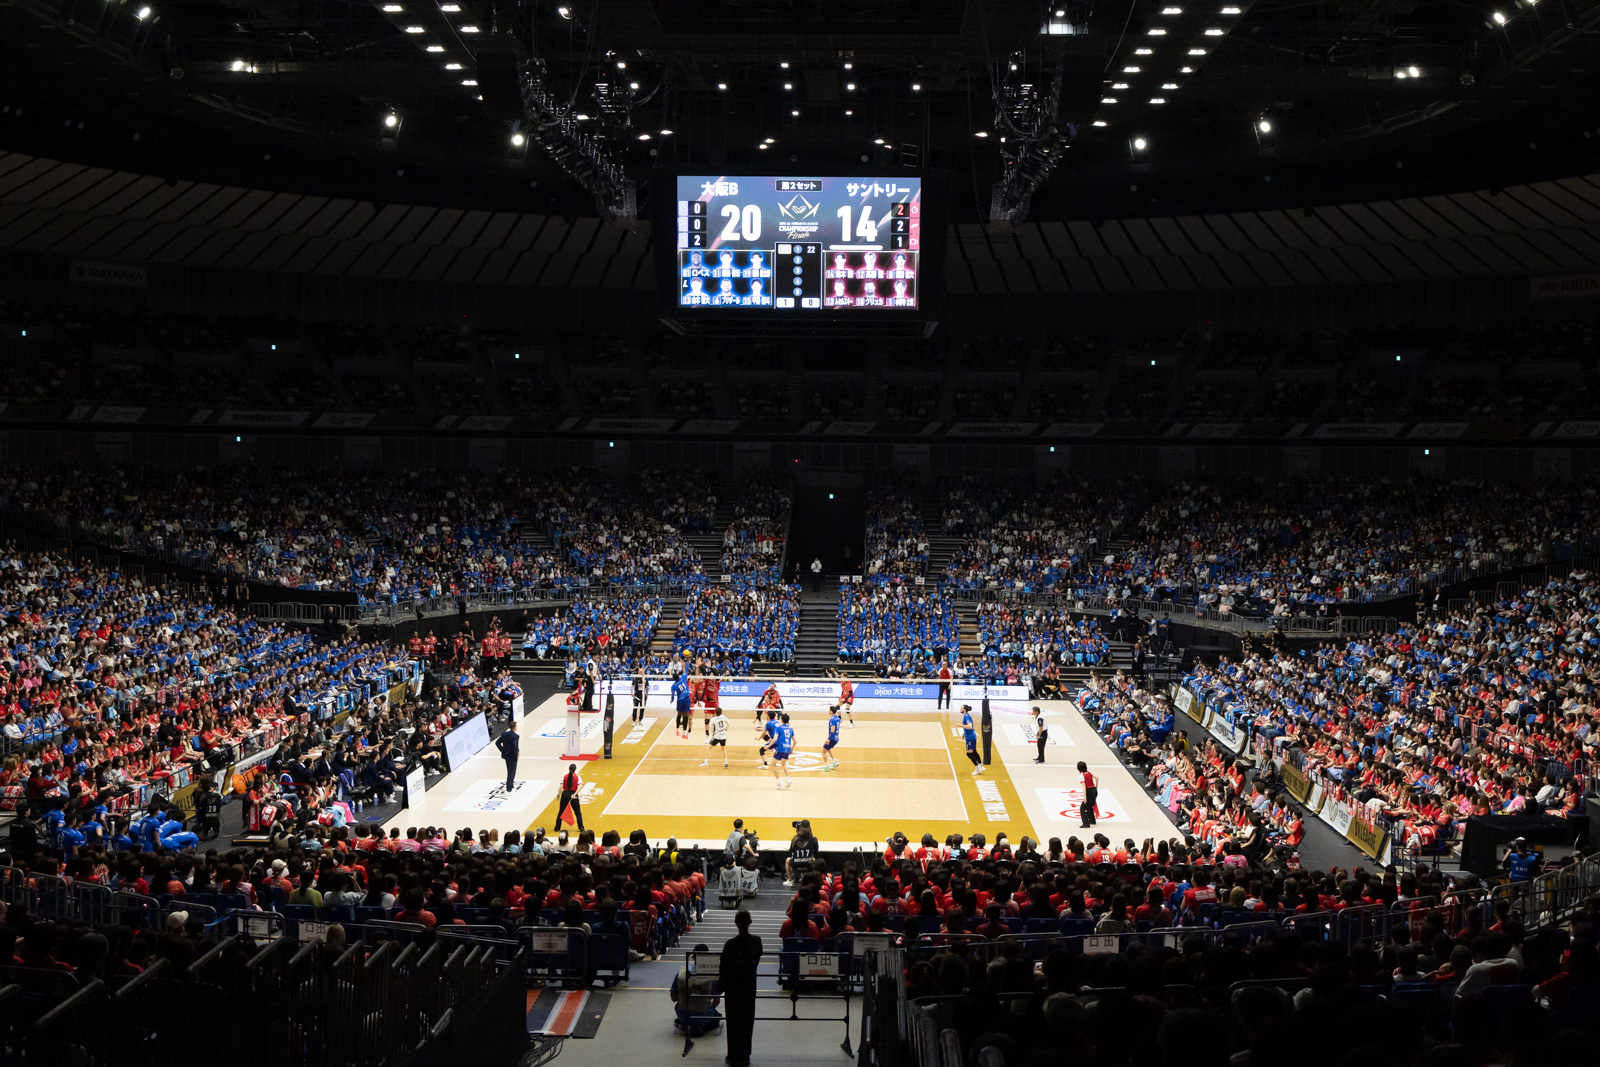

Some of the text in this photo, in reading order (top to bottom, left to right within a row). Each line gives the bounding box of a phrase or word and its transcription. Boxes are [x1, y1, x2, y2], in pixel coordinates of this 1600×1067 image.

[701, 182, 739, 196] 大阪B
[781, 181, 816, 190] 第2セット
[846, 183, 910, 197] サントリー
[694, 203, 701, 214] 0
[897, 205, 904, 216] 2
[694, 219, 701, 230] 0
[721, 204, 762, 241] 20
[837, 205, 878, 242] 14
[897, 220, 904, 232] 2
[694, 235, 701, 246] 2
[786, 231, 810, 240] Finals
[897, 236, 903, 248] 1
[807, 246, 816, 254] 22
[88, 268, 143, 280] TAKENAKA
[1561, 279, 1599, 291] KIRIN
[718, 685, 749, 693] 大同生命
[806, 686, 834, 694] 大同生命
[893, 688, 923, 696] 大同生命
[784, 729, 791, 738] 15
[796, 849, 810, 858] 117
